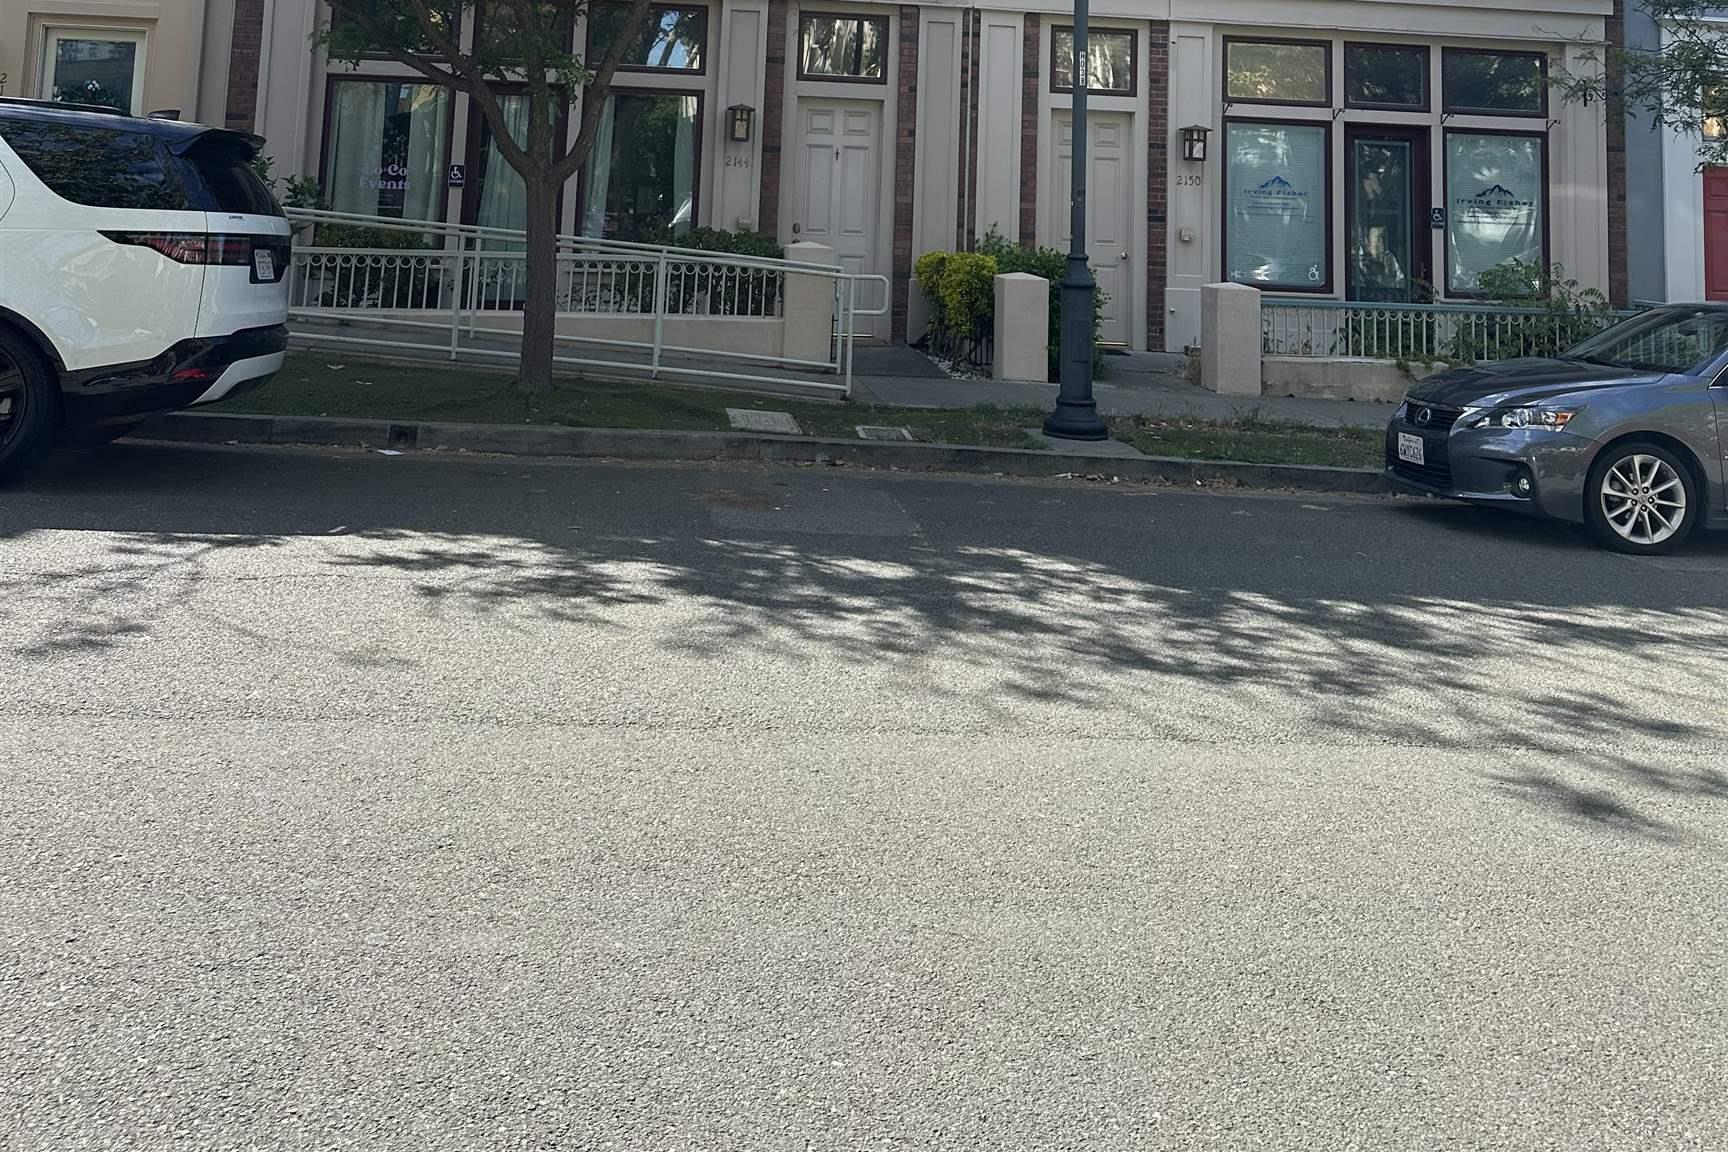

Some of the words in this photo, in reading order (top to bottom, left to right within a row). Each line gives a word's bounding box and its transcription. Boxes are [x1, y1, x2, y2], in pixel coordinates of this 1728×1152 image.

[725, 155, 751, 168] 2144
[360, 178, 410, 190] Events
[1176, 175, 1201, 186] 2150
[1456, 197, 1492, 207] Irving
[1496, 198, 1534, 208] Fisher
